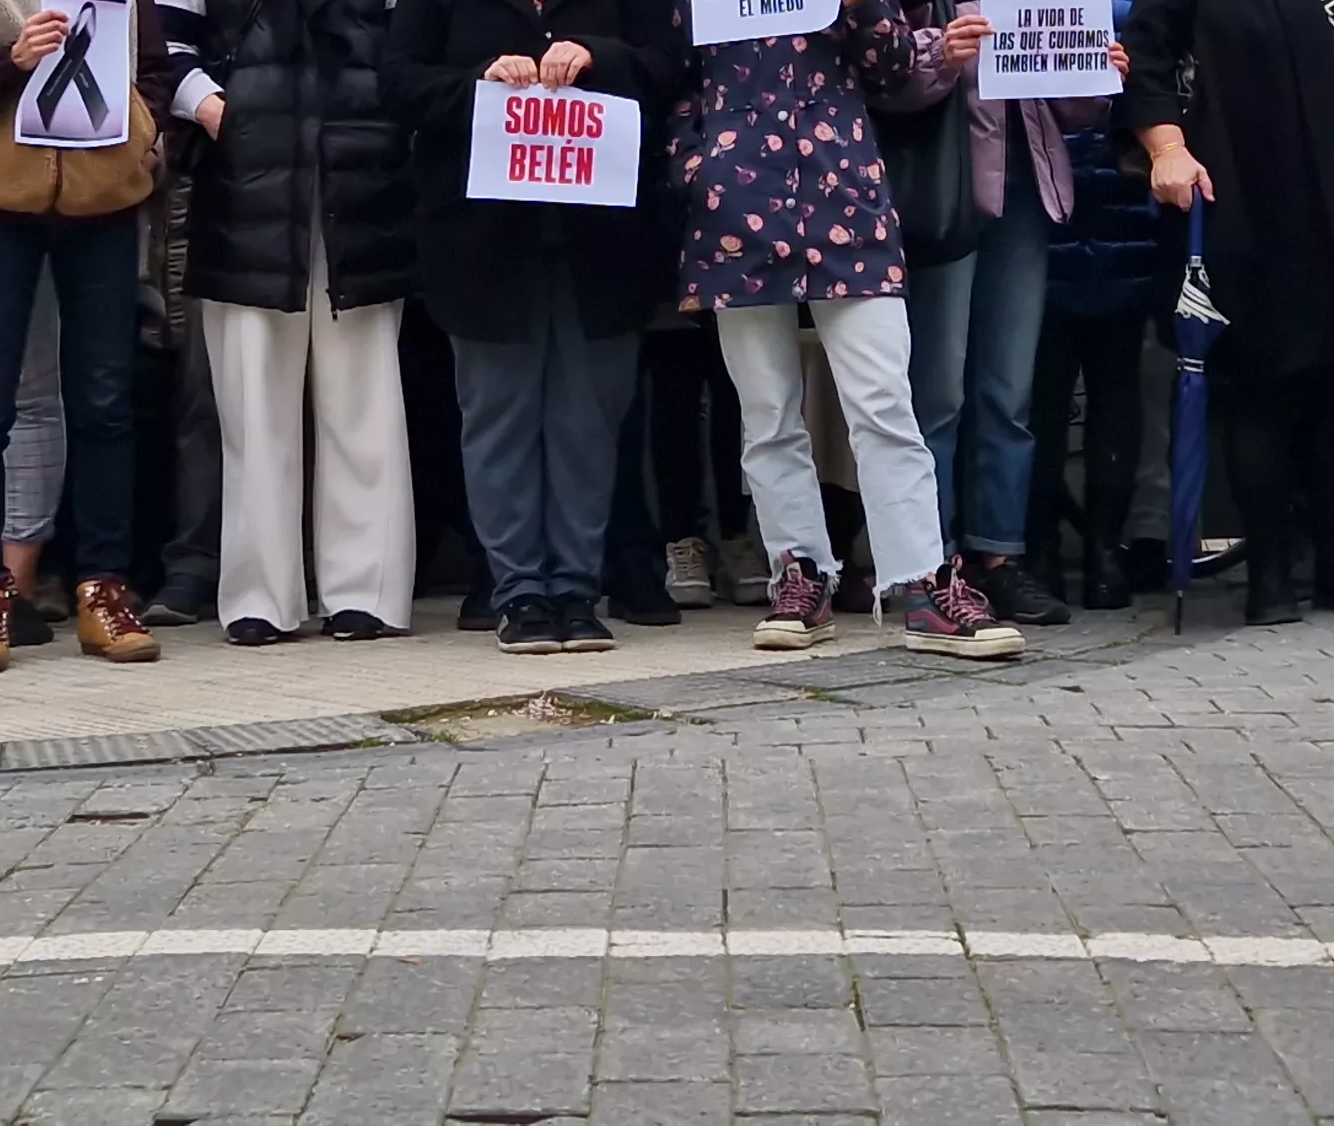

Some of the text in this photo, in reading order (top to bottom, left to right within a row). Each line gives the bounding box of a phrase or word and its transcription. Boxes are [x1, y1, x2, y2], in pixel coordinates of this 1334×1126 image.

[1018, 7, 1085, 28] LA VIDA DE
[993, 29, 1110, 51] LAS QUE CUIDAMOS
[995, 50, 1108, 73] TAMBIÉN IMPORTA
[505, 96, 605, 139] SOMOS
[509, 139, 594, 186] BELÉN
